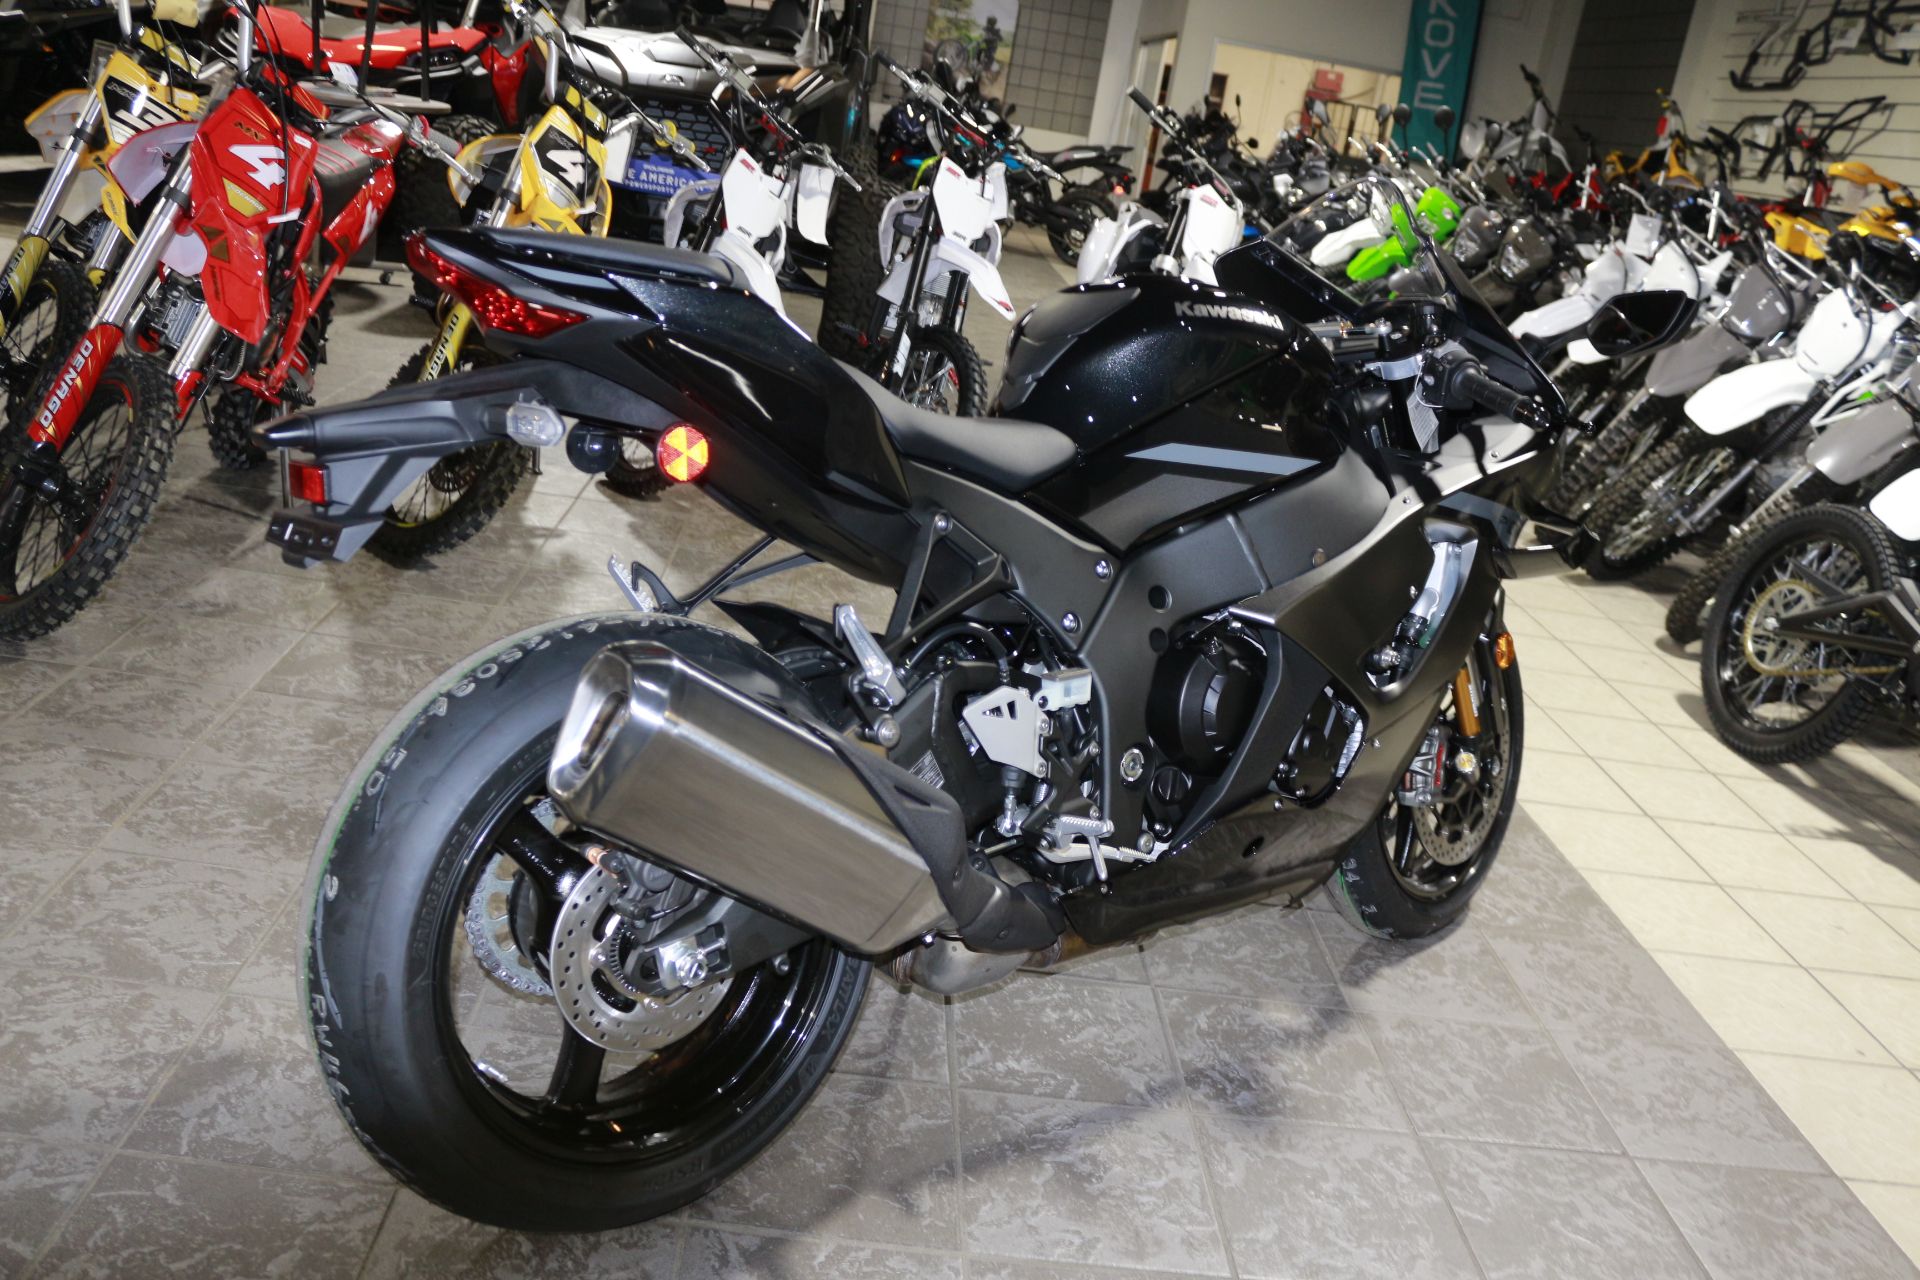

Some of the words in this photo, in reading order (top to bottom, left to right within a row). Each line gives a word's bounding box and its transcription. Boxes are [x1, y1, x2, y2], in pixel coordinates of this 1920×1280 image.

[228, 144, 287, 191] 4
[546, 150, 586, 190] 4
[1174, 300, 1285, 331] Kawasaki
[39, 338, 95, 429] DENAGO
